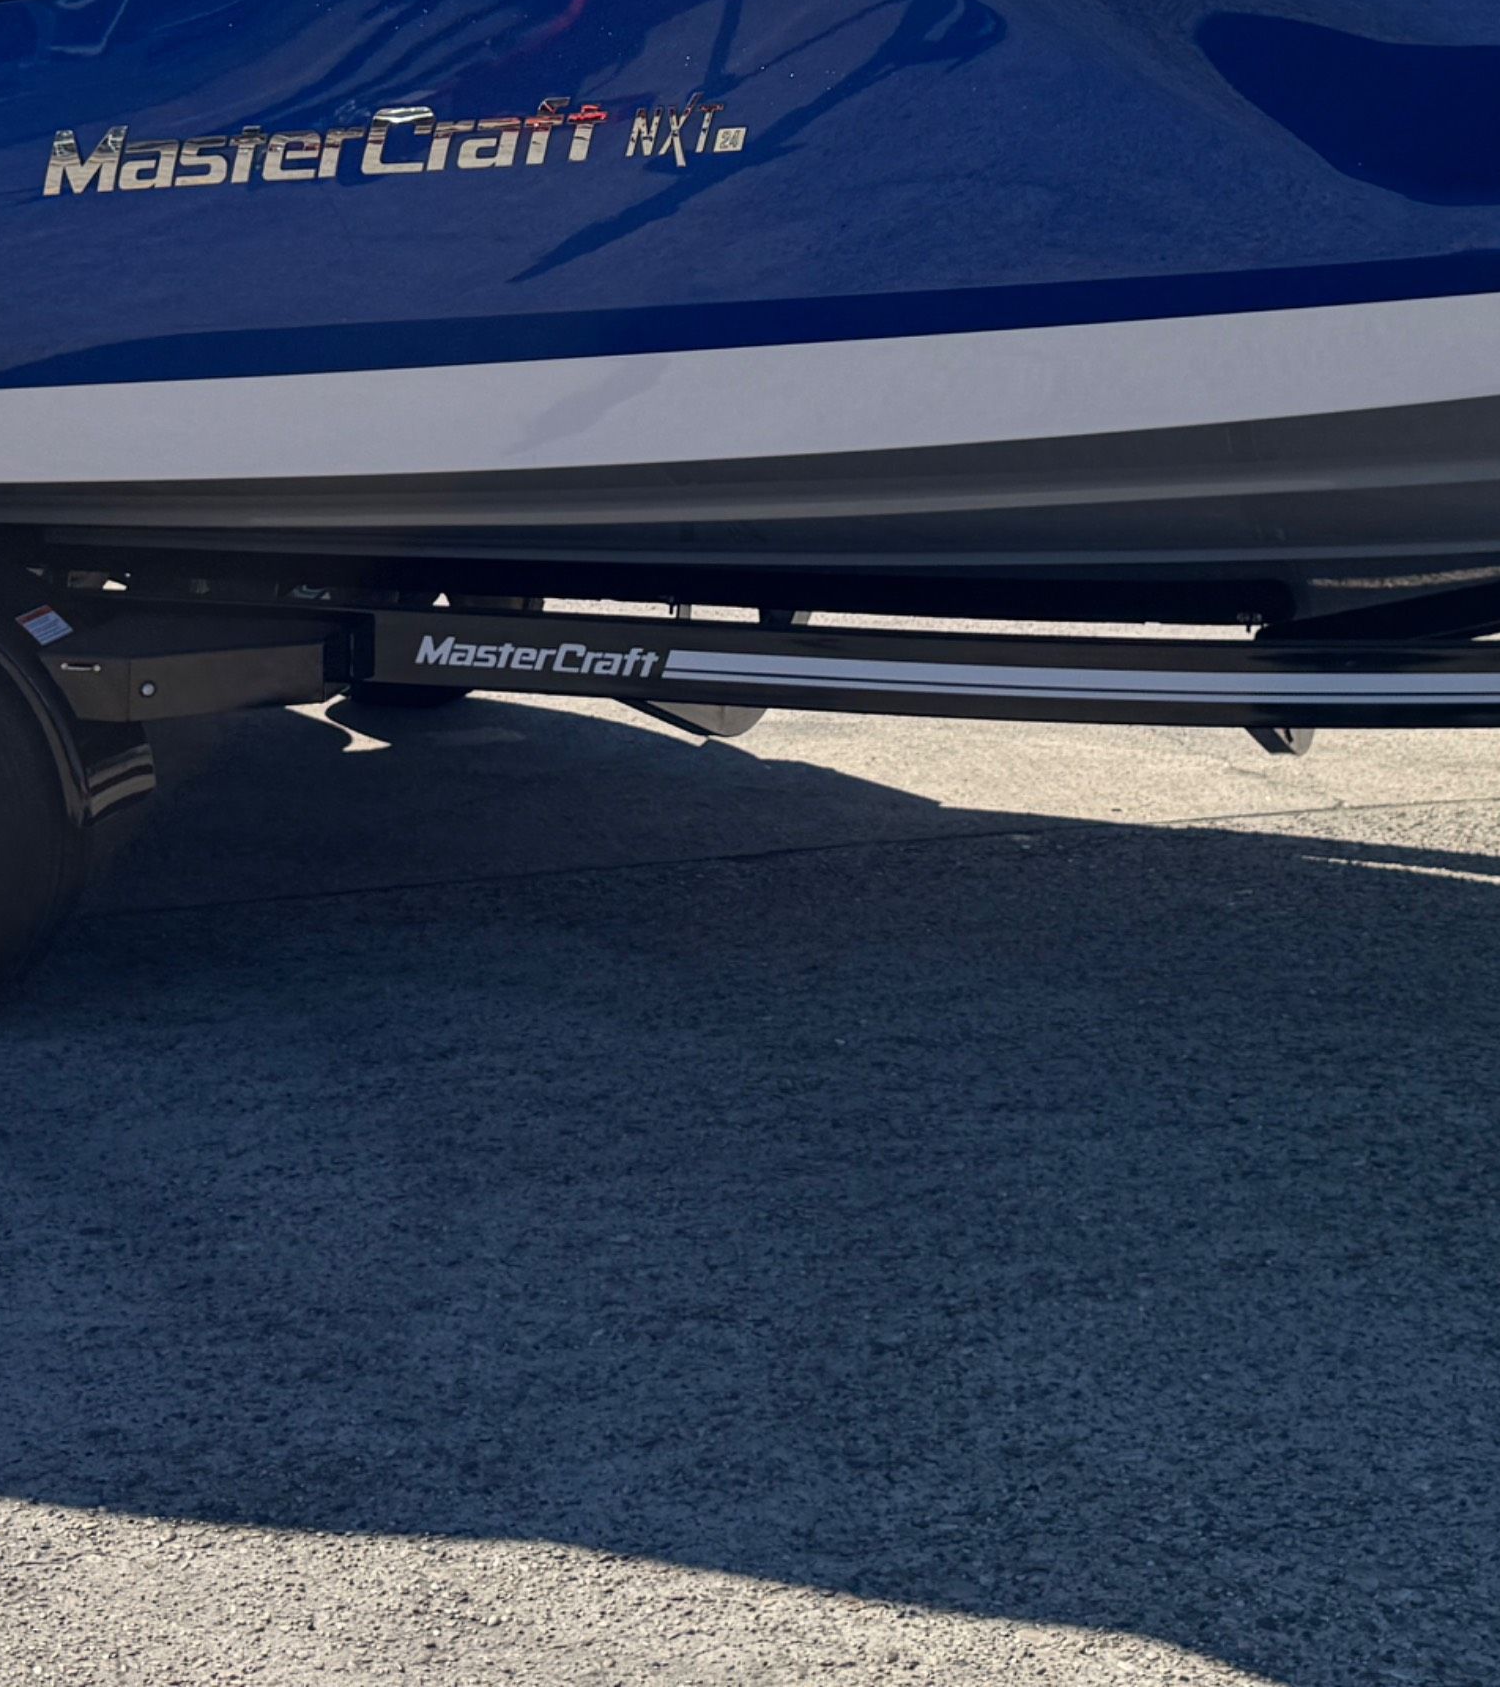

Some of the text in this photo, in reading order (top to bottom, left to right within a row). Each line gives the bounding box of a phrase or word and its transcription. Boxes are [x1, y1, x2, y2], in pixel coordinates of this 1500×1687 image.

[42, 98, 607, 196] MasterCraft
[625, 92, 724, 167] NXT
[415, 635, 659, 677] MasterCraft
